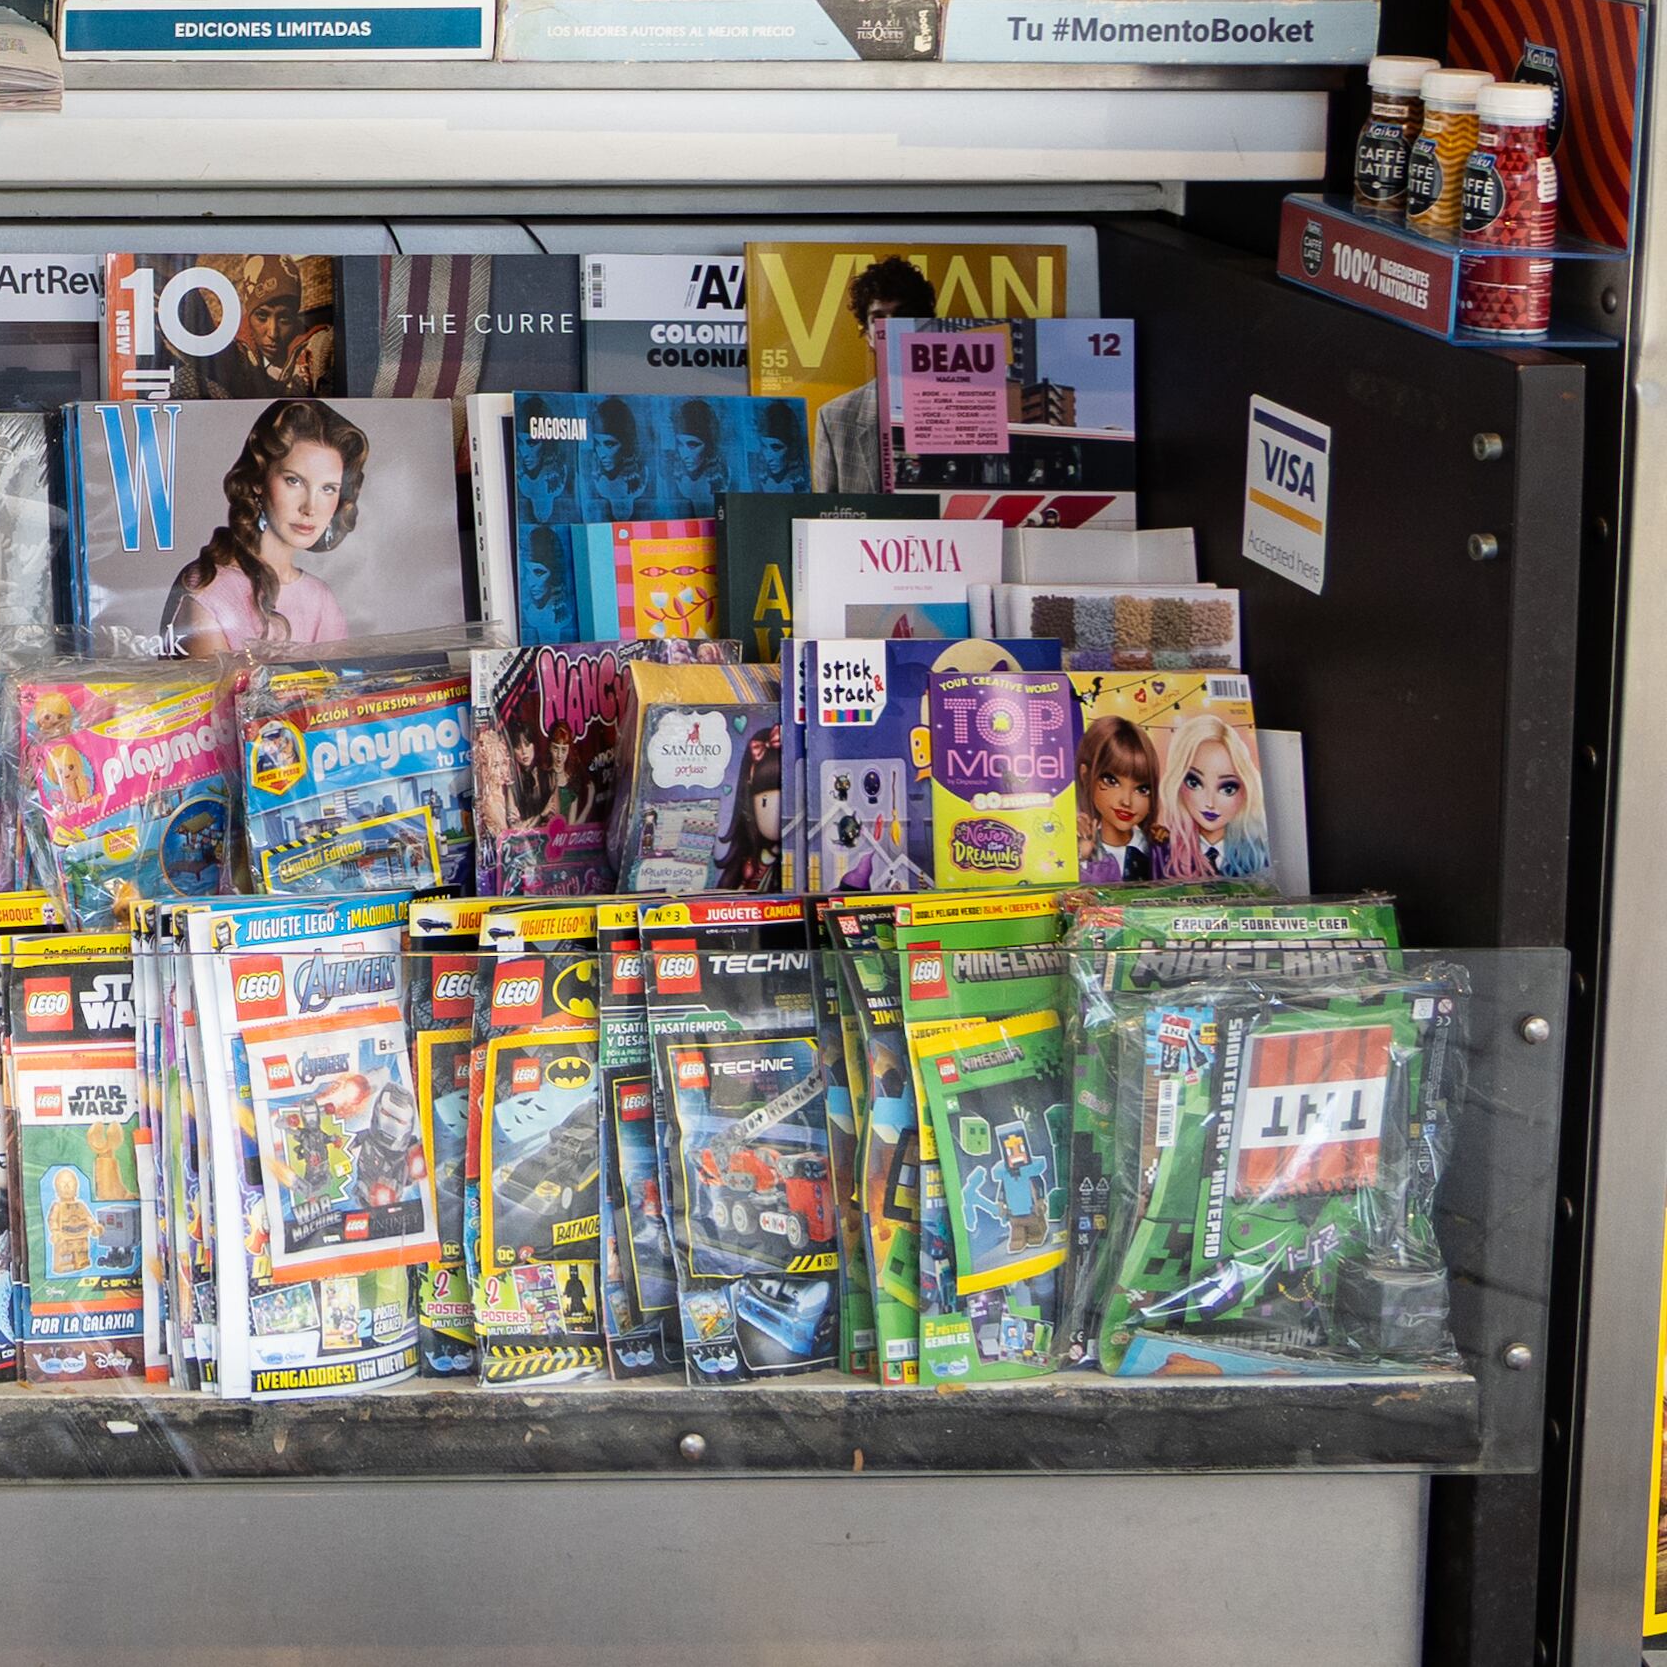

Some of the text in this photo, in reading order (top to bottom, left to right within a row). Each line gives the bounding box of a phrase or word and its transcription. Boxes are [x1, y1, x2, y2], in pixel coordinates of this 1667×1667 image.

[175, 22, 371, 39] EDICIONES LIMITADAS
[1008, 16, 1314, 45] Tu #MomentoBooket
[1332, 242, 1380, 290] 100%
[1380, 257, 1430, 289] INGREDIENTES
[1379, 278, 1428, 310] NATURALES
[911, 333, 1121, 372] BEAU 12
[530, 418, 587, 440] GAGOSIAN
[1259, 439, 1315, 502] VISA
[1247, 530, 1322, 585] Accepted here
[654, 1019, 727, 1034] PASATIEMPOS
[711, 1056, 793, 1076] TECHNIC
